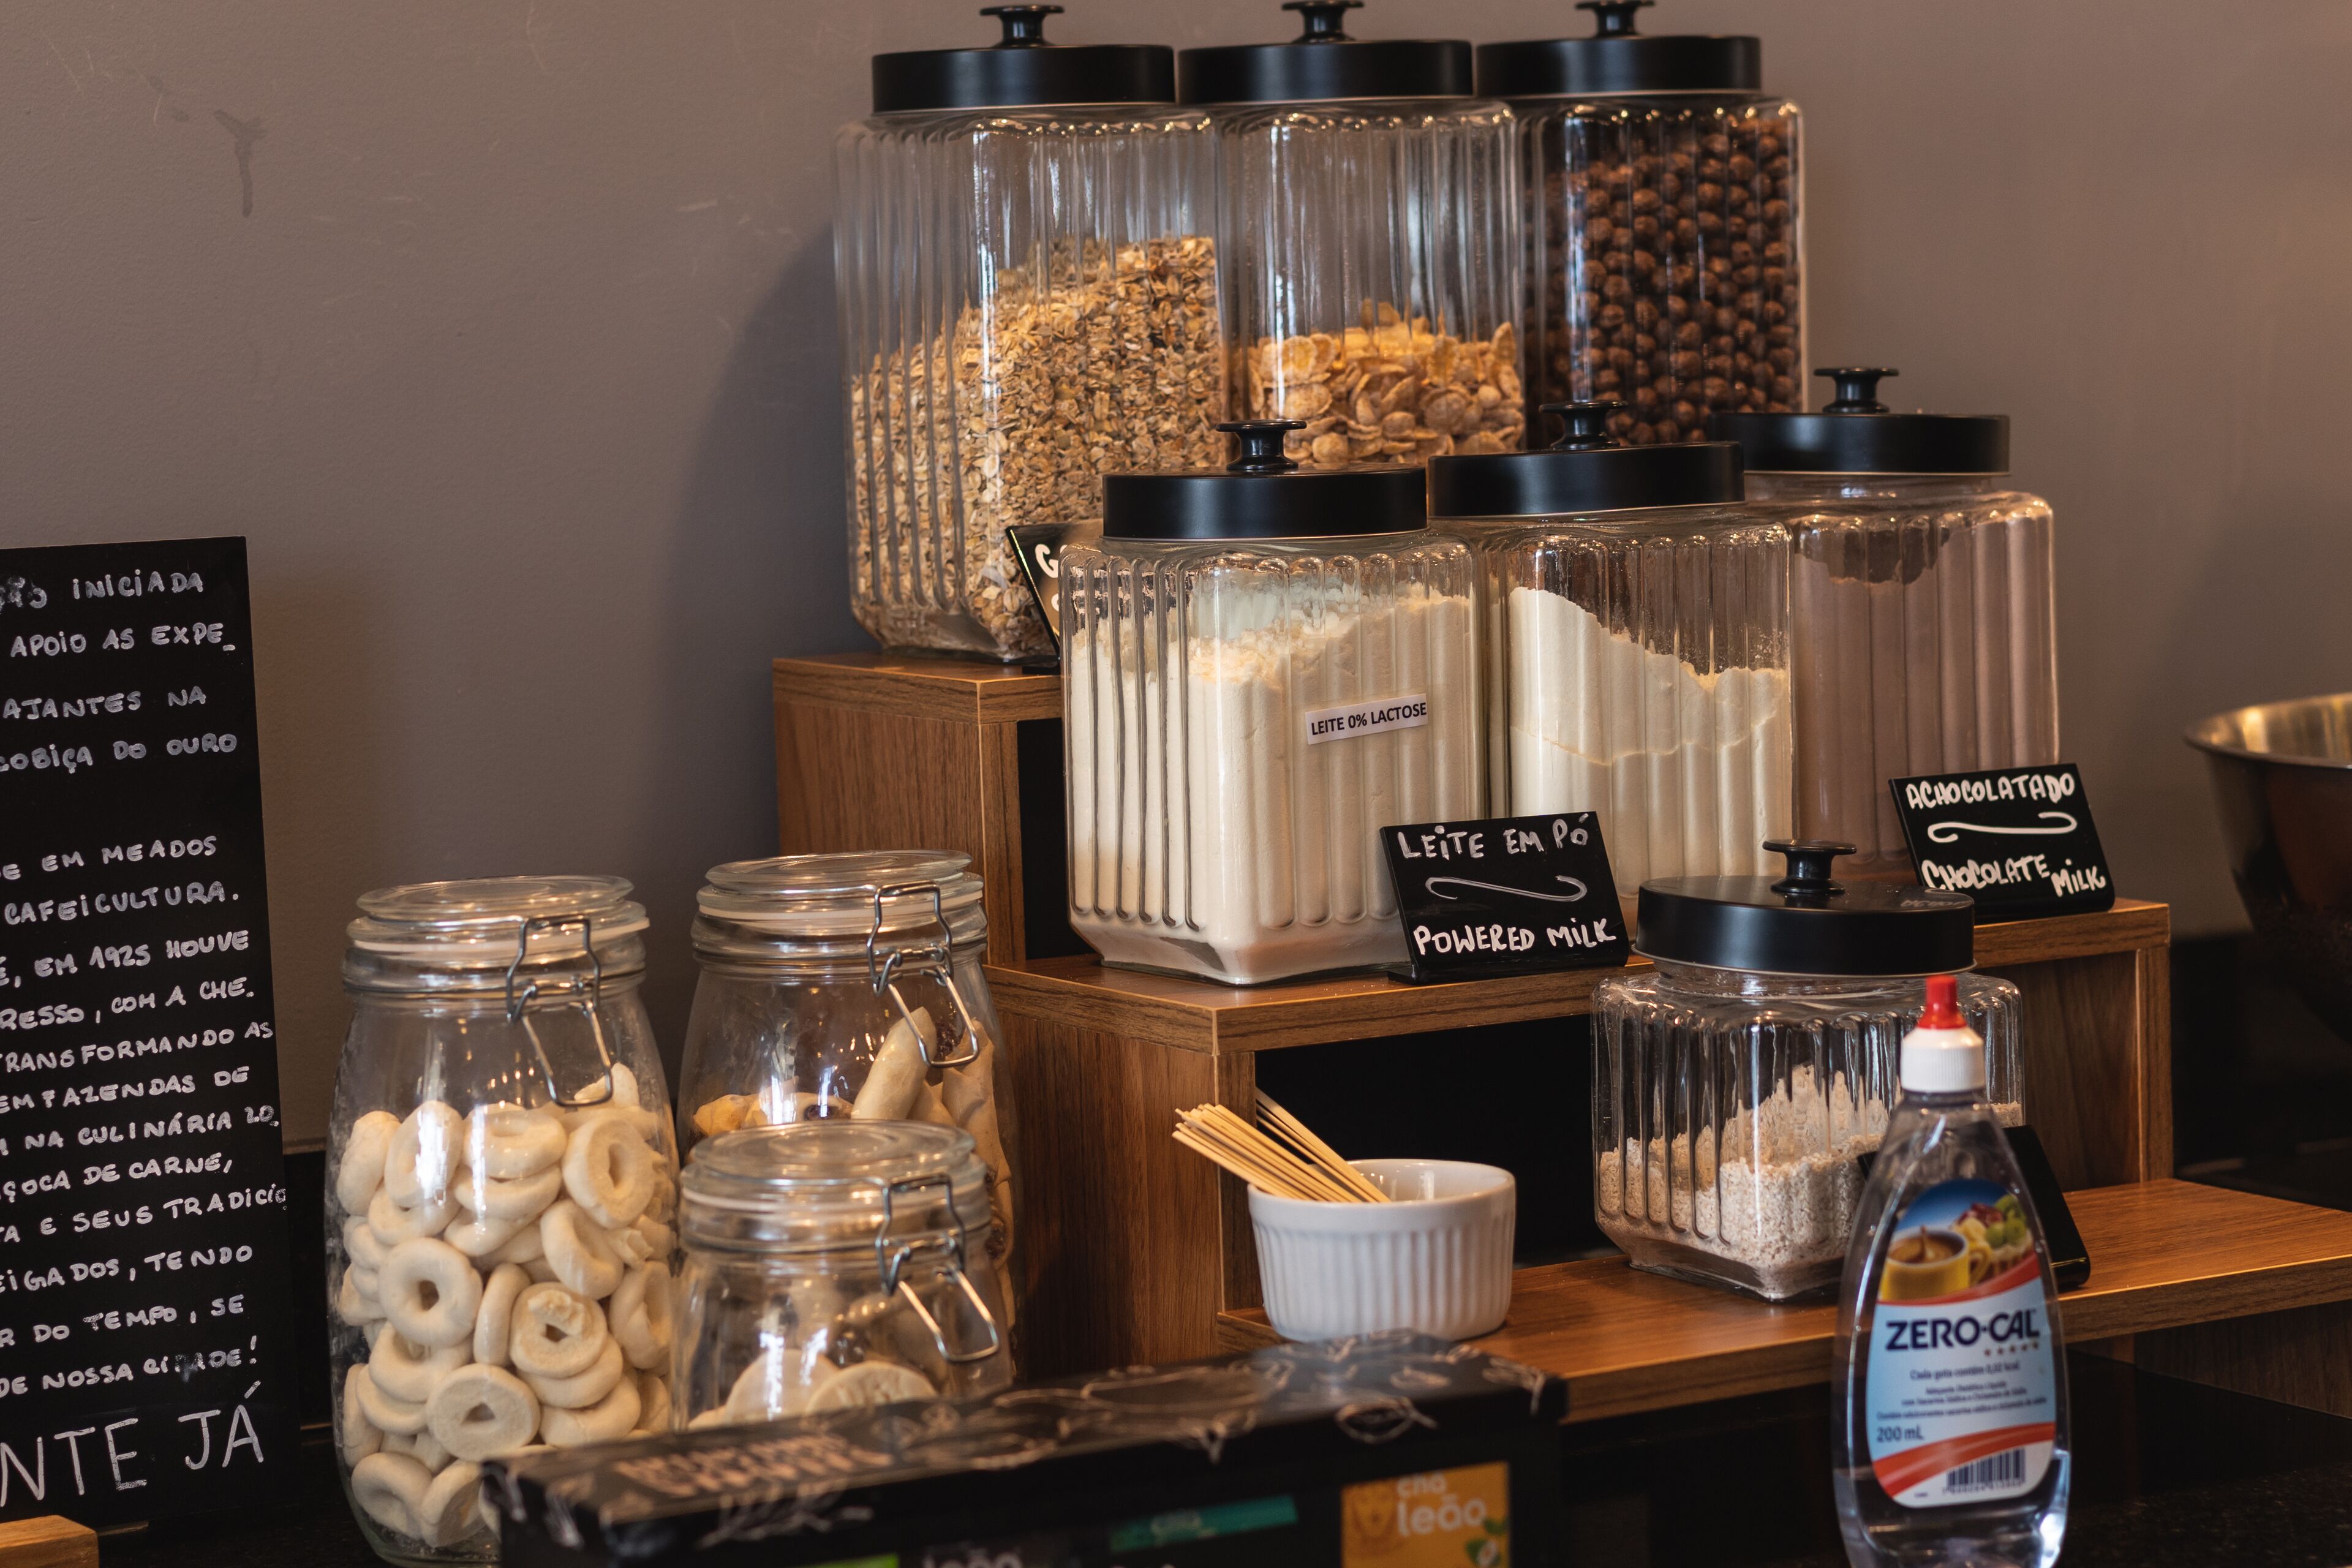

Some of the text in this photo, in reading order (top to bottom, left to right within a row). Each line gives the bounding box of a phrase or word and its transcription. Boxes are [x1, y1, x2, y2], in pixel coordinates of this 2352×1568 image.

[102, 628, 135, 650] AS
[2, 686, 206, 720] AJANTES NA
[1311, 702, 1427, 736] LEITE 0% LACTOSE
[113, 741, 146, 760] DO
[166, 733, 237, 755] OURO
[1905, 772, 2075, 810] ACHOCOLATADO
[1502, 828, 1545, 854] EM
[1551, 813, 1589, 848] PÓ
[0, 835, 217, 880] E EM MEADOS
[1920, 853, 2052, 892] CHOCOLATE
[34, 953, 78, 978] EM
[89, 944, 151, 969] 1925
[165, 929, 249, 959] HOUVE
[1413, 924, 1535, 956] POWERED
[111, 992, 156, 1014] COM
[164, 985, 187, 1007] A
[0, 1022, 273, 1073] RANSFORMANDO AS
[41, 1074, 196, 1108] FAZENDAS
[214, 1066, 250, 1087] DE
[24, 1131, 64, 1150] NA
[78, 1111, 232, 1145] CULINÁRIA
[0, 1152, 233, 1203] ÇOCA DE CARNE,
[40, 1217, 57, 1235] E
[72, 1205, 153, 1232] SEUS
[143, 1245, 252, 1272] TENDO
[32, 1324, 70, 1343] DO
[210, 1294, 244, 1316] SE
[42, 1363, 134, 1390] NOSSA
[178, 1378, 264, 1470] JÁ
[1877, 1427, 1902, 1442] 200
